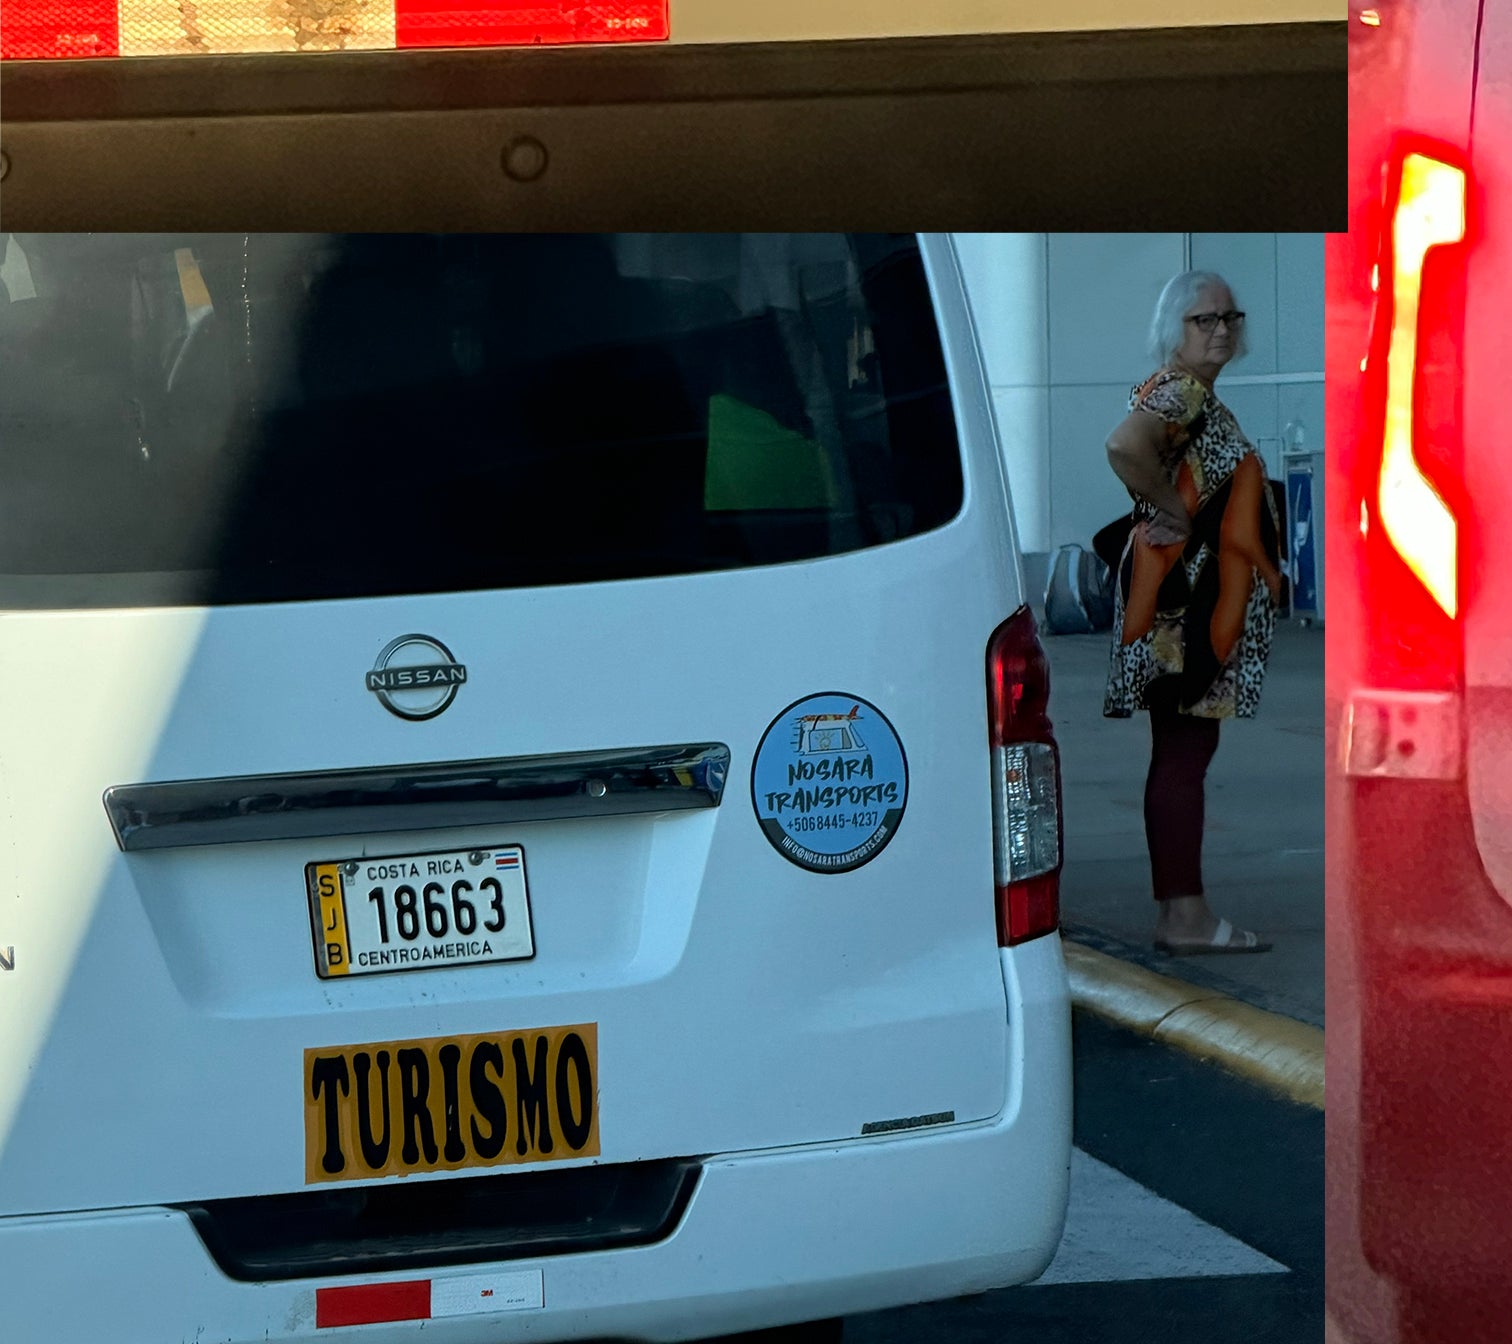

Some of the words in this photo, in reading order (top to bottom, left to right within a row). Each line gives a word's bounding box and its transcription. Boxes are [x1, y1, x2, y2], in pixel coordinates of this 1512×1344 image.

[370, 667, 466, 687] NISSAN
[788, 754, 874, 786] NOSARA
[765, 782, 899, 814] TRANSPORTS
[366, 863, 420, 881] COSTA
[427, 859, 465, 876] RICA
[368, 877, 506, 944] 18663
[358, 940, 493, 967] CENTROAMERICA
[312, 1032, 592, 1173] TURISMO
